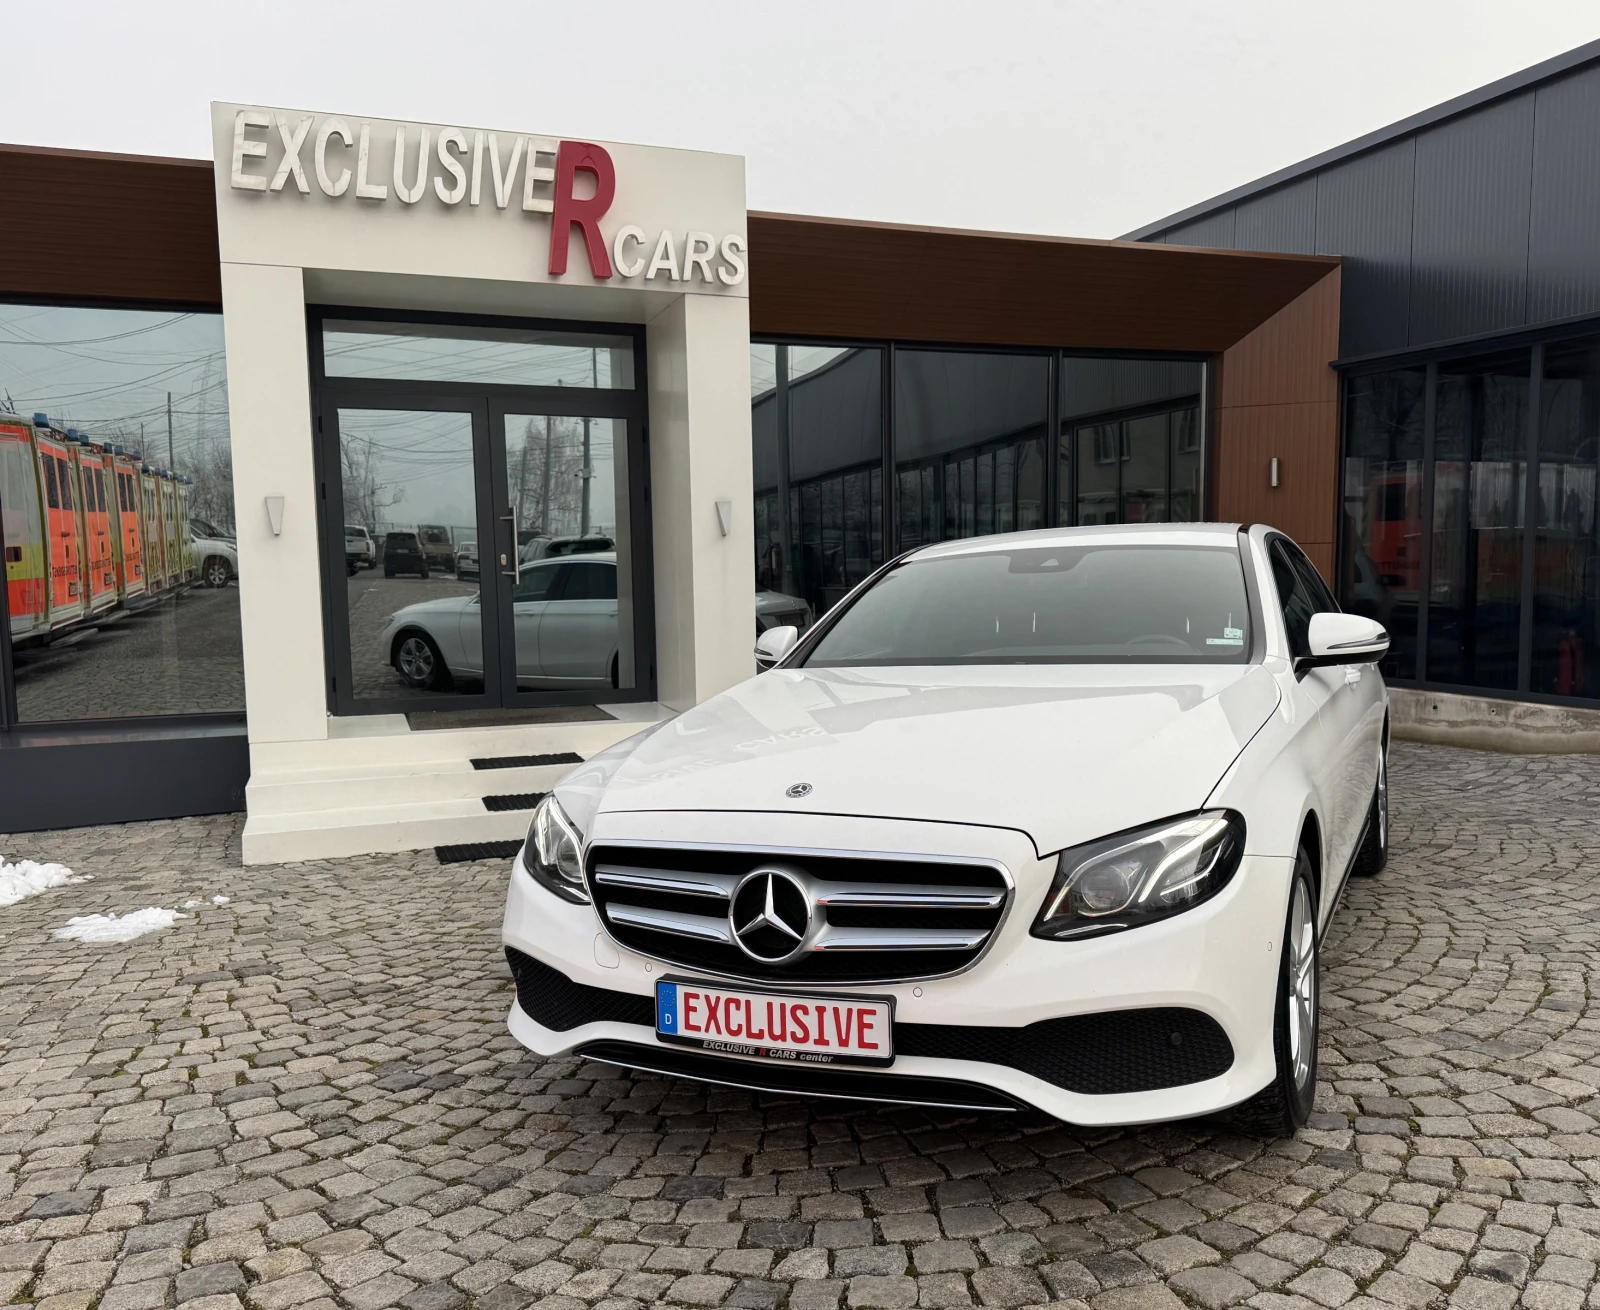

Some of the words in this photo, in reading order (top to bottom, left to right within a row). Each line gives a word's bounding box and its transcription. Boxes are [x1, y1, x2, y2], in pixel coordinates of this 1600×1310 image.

[230, 110, 558, 215] EXCLUSIVE
[548, 140, 616, 279] R
[613, 224, 747, 286] CARS
[665, 1013, 672, 1025] D
[683, 991, 879, 1050] EXCLUSIVE
[703, 1040, 756, 1055] EXCLUSIVE
[769, 1049, 797, 1060] CARS
[800, 1053, 833, 1063] center
